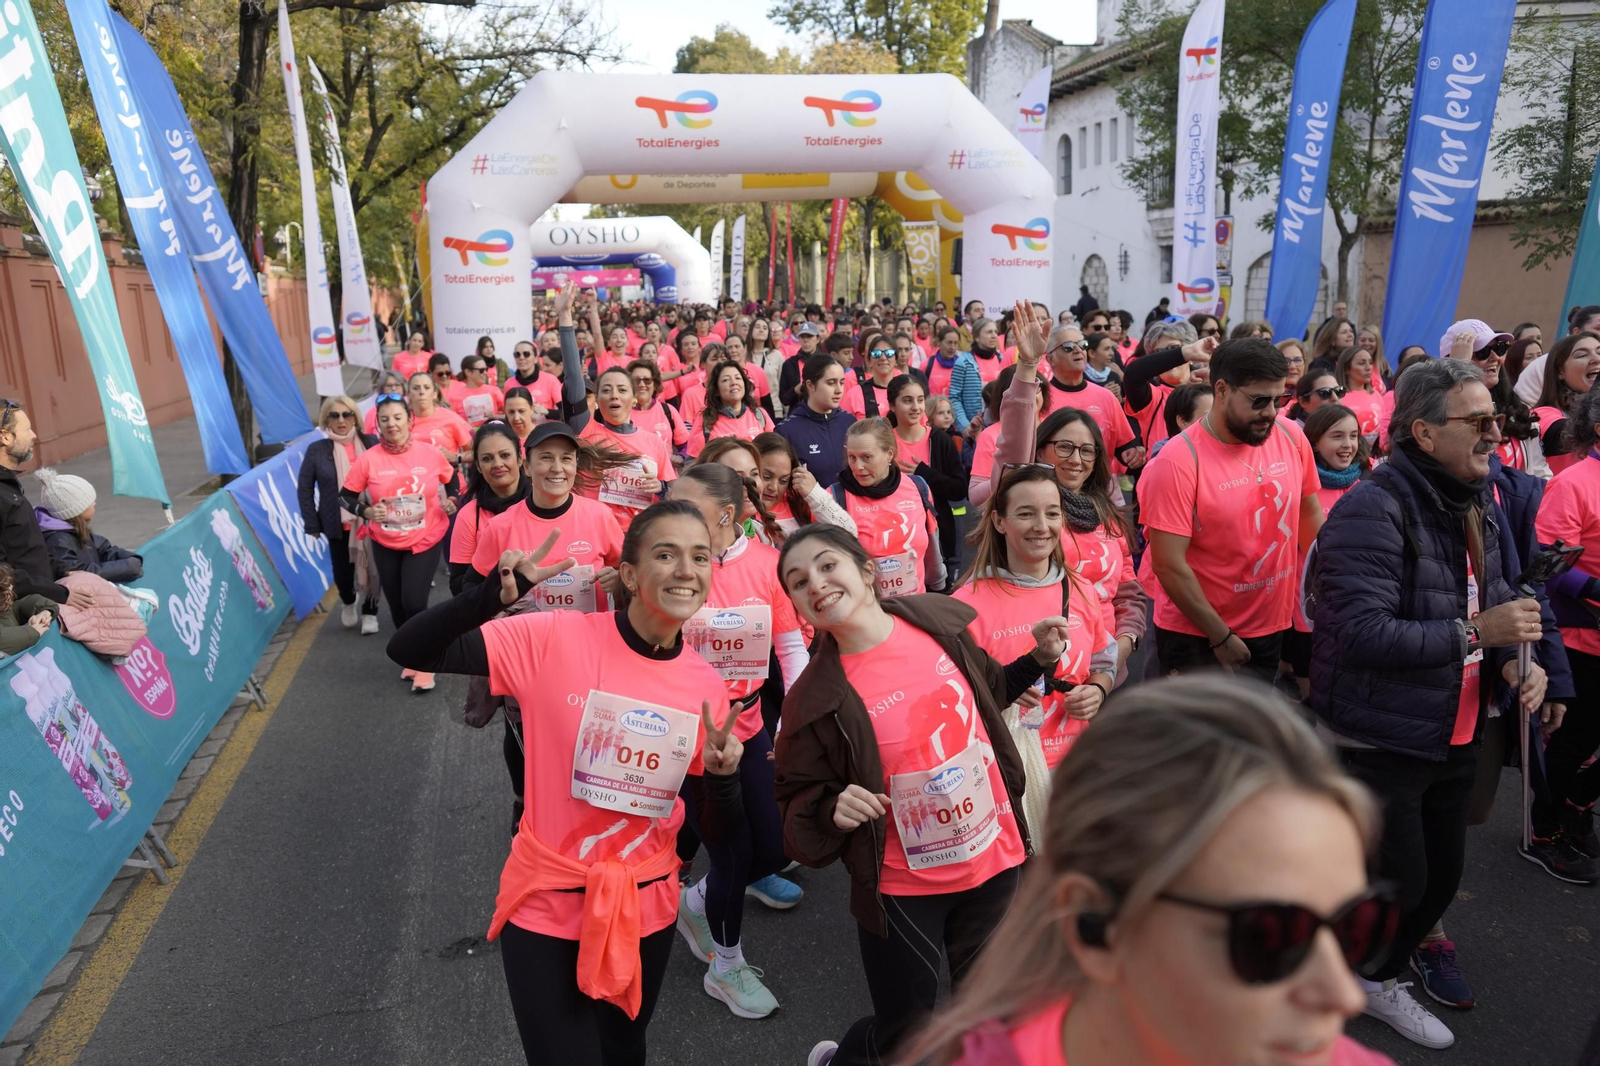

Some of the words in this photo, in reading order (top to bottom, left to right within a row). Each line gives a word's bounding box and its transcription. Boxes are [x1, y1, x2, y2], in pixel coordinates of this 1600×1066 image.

[636, 137, 720, 150] TotalEnergies
[804, 135, 883, 148] TotalEnergies
[1408, 50, 1487, 223] Marlene
[1283, 101, 1329, 244] Marlene
[663, 180, 675, 189] de
[677, 180, 716, 190] Deportes
[549, 224, 640, 246] OYSHO
[444, 274, 516, 286] TotalEnergies
[445, 325, 516, 336] totalenergies.es
[621, 476, 642, 487] 016
[1219, 477, 1249, 491] OYSHO
[881, 577, 903, 589] 016
[169, 545, 213, 655] Batiste
[546, 594, 574, 605] 016
[711, 619, 744, 627] ASTURIANA
[993, 623, 1032, 640] OYSHO
[712, 638, 744, 651] 016
[143, 676, 169, 706] ESPAÑA
[867, 690, 905, 718] YSHO
[593, 711, 617, 722] SUMA
[624, 715, 667, 733] ASTURIANA
[616, 746, 661, 771] 016
[623, 773, 645, 785] 3630
[928, 773, 964, 793] ASTURIANA
[586, 776, 612, 787] CARRERA
[612, 781, 620, 789] DE
[621, 783, 628, 791] LA
[629, 785, 647, 795] MUJER
[650, 789, 668, 798] SEVILLA
[580, 786, 617, 803] OYSHO
[898, 790, 921, 800] SUMA
[638, 801, 666, 811] Santander
[936, 797, 974, 824] 016
[995, 801, 1013, 816] UJE
[952, 823, 971, 837] 3631
[921, 842, 946, 852] CARRERA
[954, 836, 962, 845] LA
[920, 850, 957, 864] OYSHO
